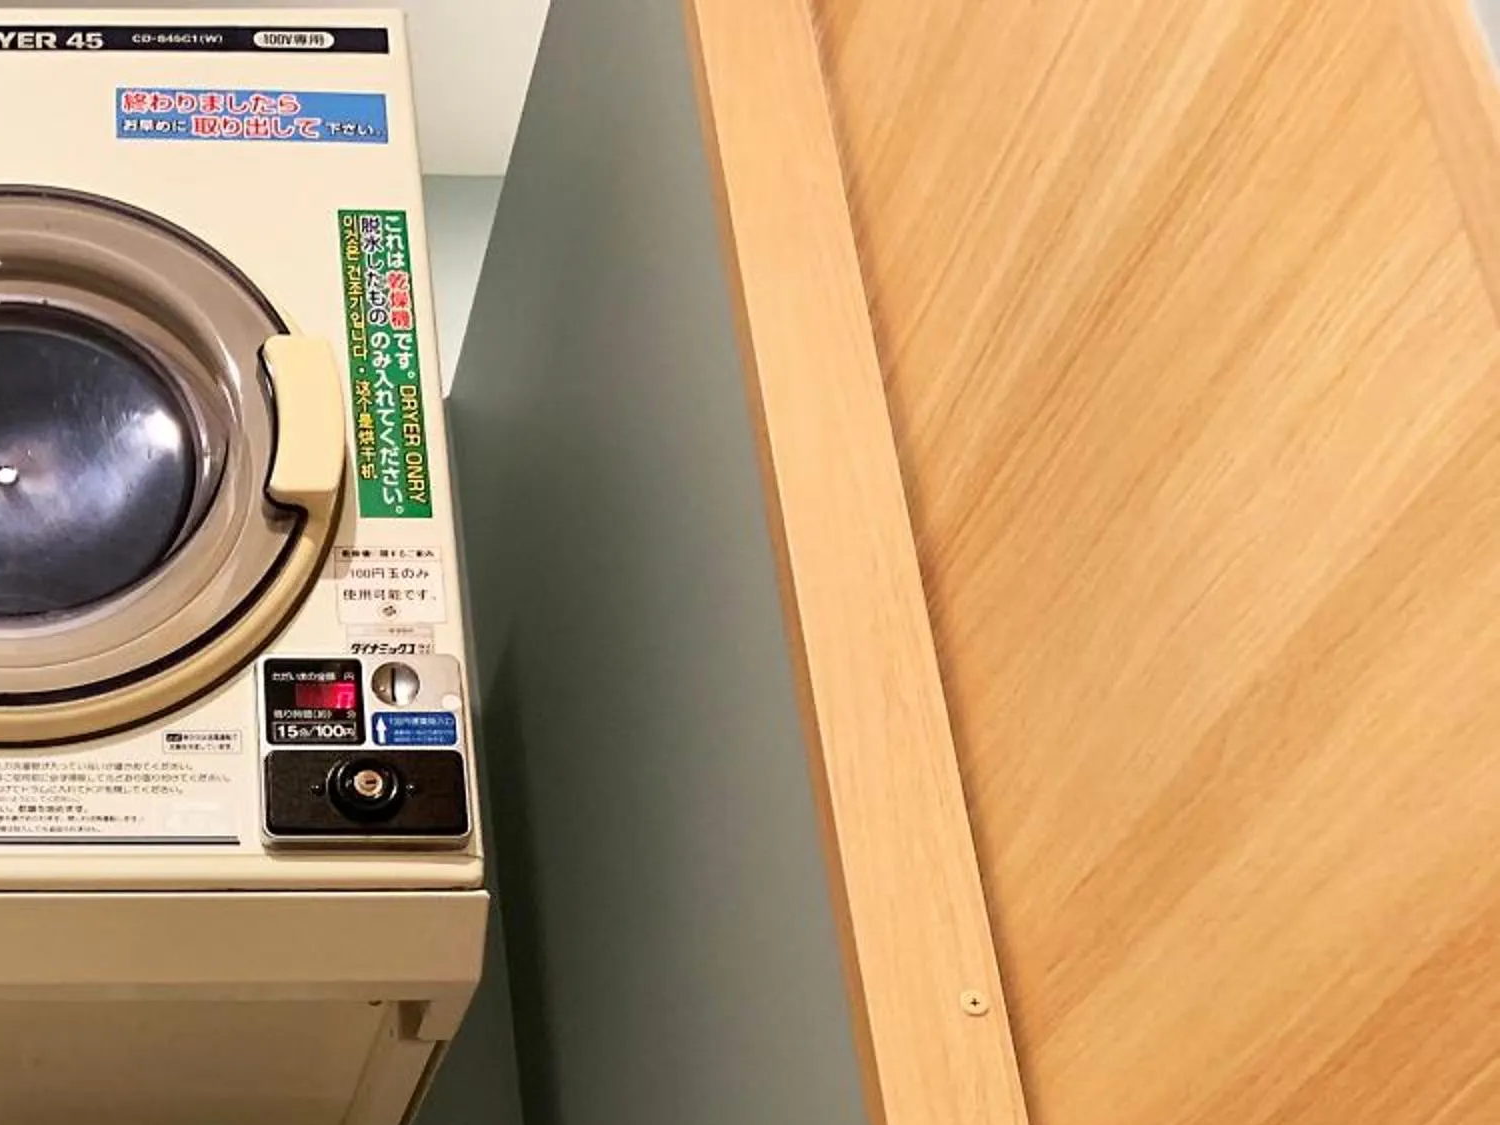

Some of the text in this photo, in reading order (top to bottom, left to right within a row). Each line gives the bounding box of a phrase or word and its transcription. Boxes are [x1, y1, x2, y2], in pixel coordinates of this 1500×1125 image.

[65, 31, 104, 50] 45
[122, 93, 300, 113] 終わりましたら
[399, 385, 428, 504] DRYER ONRY
